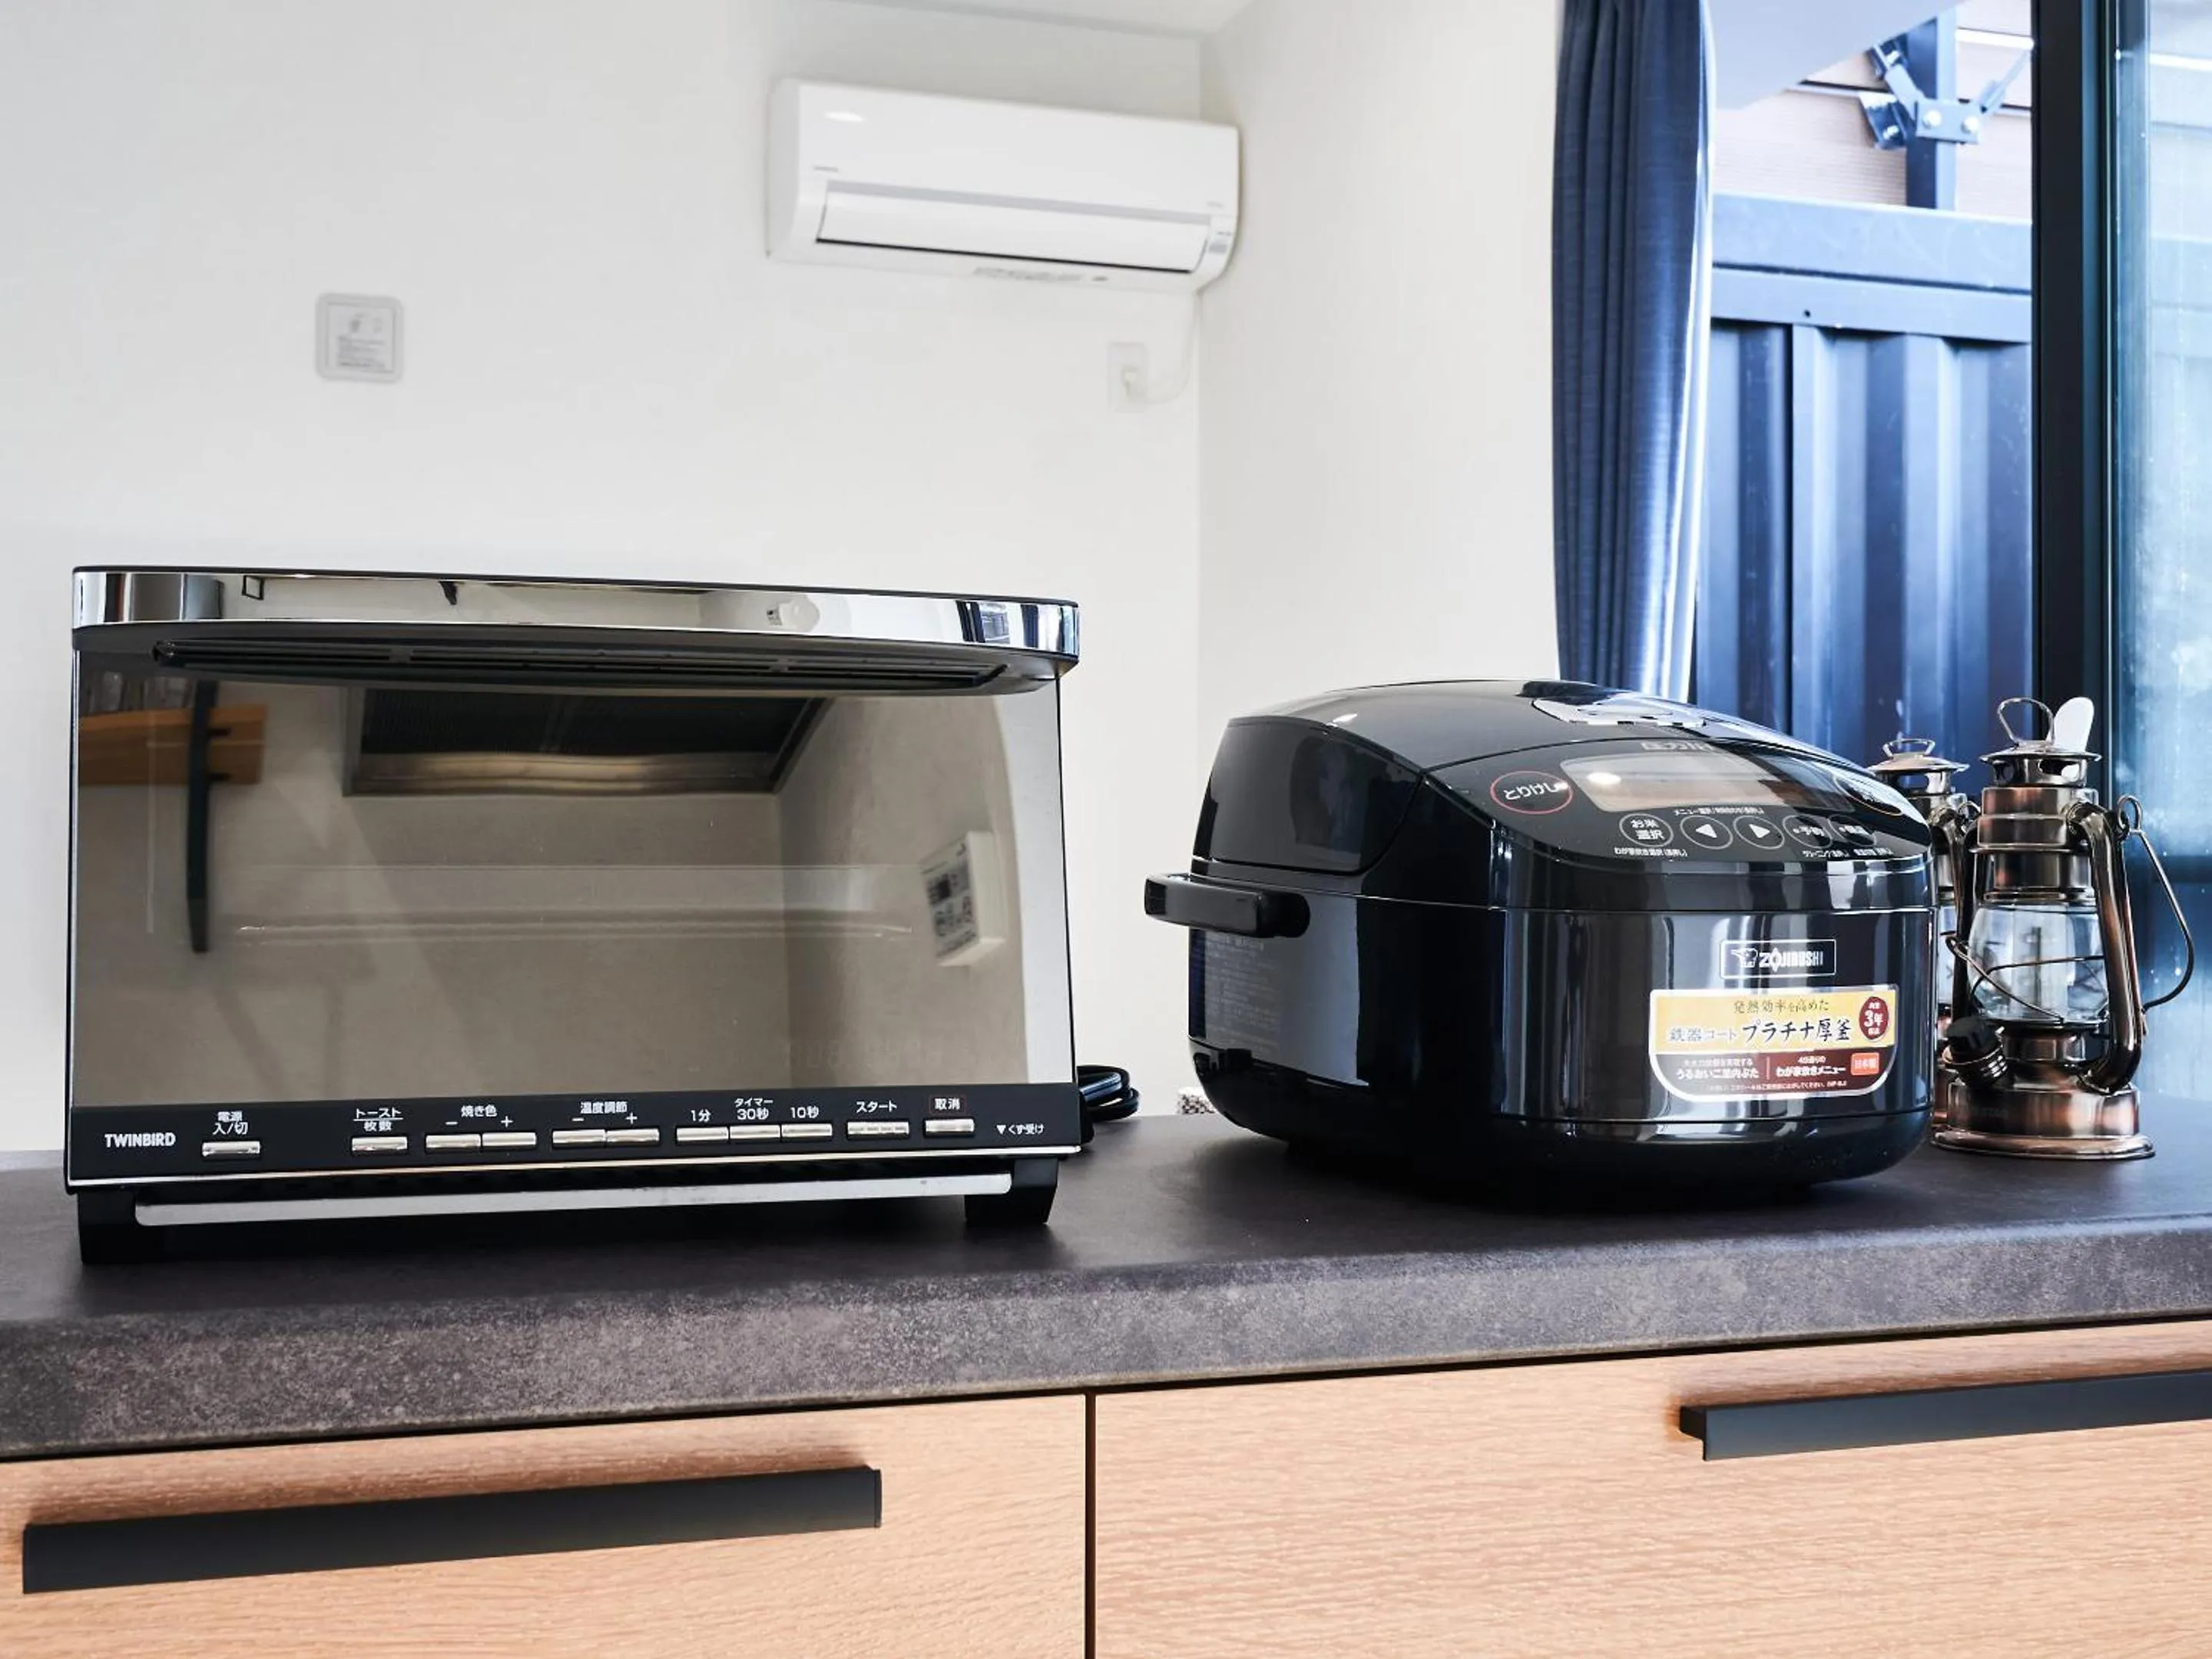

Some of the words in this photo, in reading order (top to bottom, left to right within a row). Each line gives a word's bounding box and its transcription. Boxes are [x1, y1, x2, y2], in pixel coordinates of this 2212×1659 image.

[1741, 1018, 1852, 1043] プラチナ厚釜
[580, 1101, 628, 1114] 温度調節
[734, 1097, 774, 1108] タイマー
[856, 1100, 898, 1114] スタート
[934, 1098, 961, 1111] 取消
[217, 1110, 243, 1123] 電源
[355, 1107, 402, 1119] トースト
[460, 1104, 498, 1118] 焼き色
[690, 1108, 712, 1123] 1分
[737, 1108, 770, 1121] 30秒
[790, 1106, 820, 1119] 10秒
[213, 1121, 249, 1136] 入/切
[363, 1121, 392, 1132] 枚数
[104, 1131, 177, 1148] TWINBIRD
